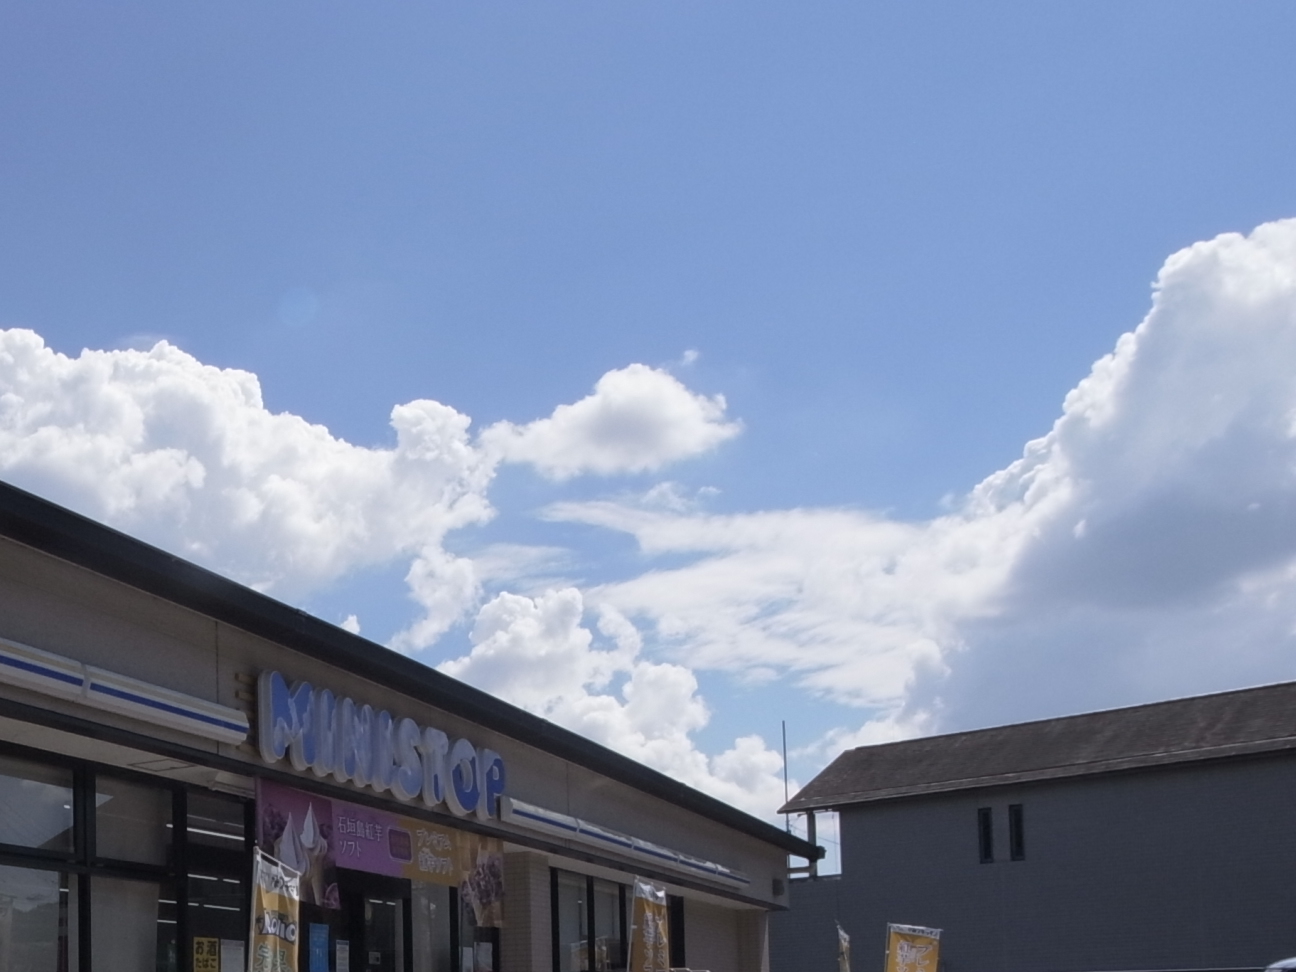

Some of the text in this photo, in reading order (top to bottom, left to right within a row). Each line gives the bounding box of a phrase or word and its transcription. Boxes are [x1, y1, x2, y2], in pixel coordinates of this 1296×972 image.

[258, 669, 507, 823] MINISTOP
[337, 815, 384, 842] 石垣島紅芋
[339, 839, 362, 858] ソフト
[195, 940, 217, 957] お酒
[195, 957, 217, 969] たばこ
